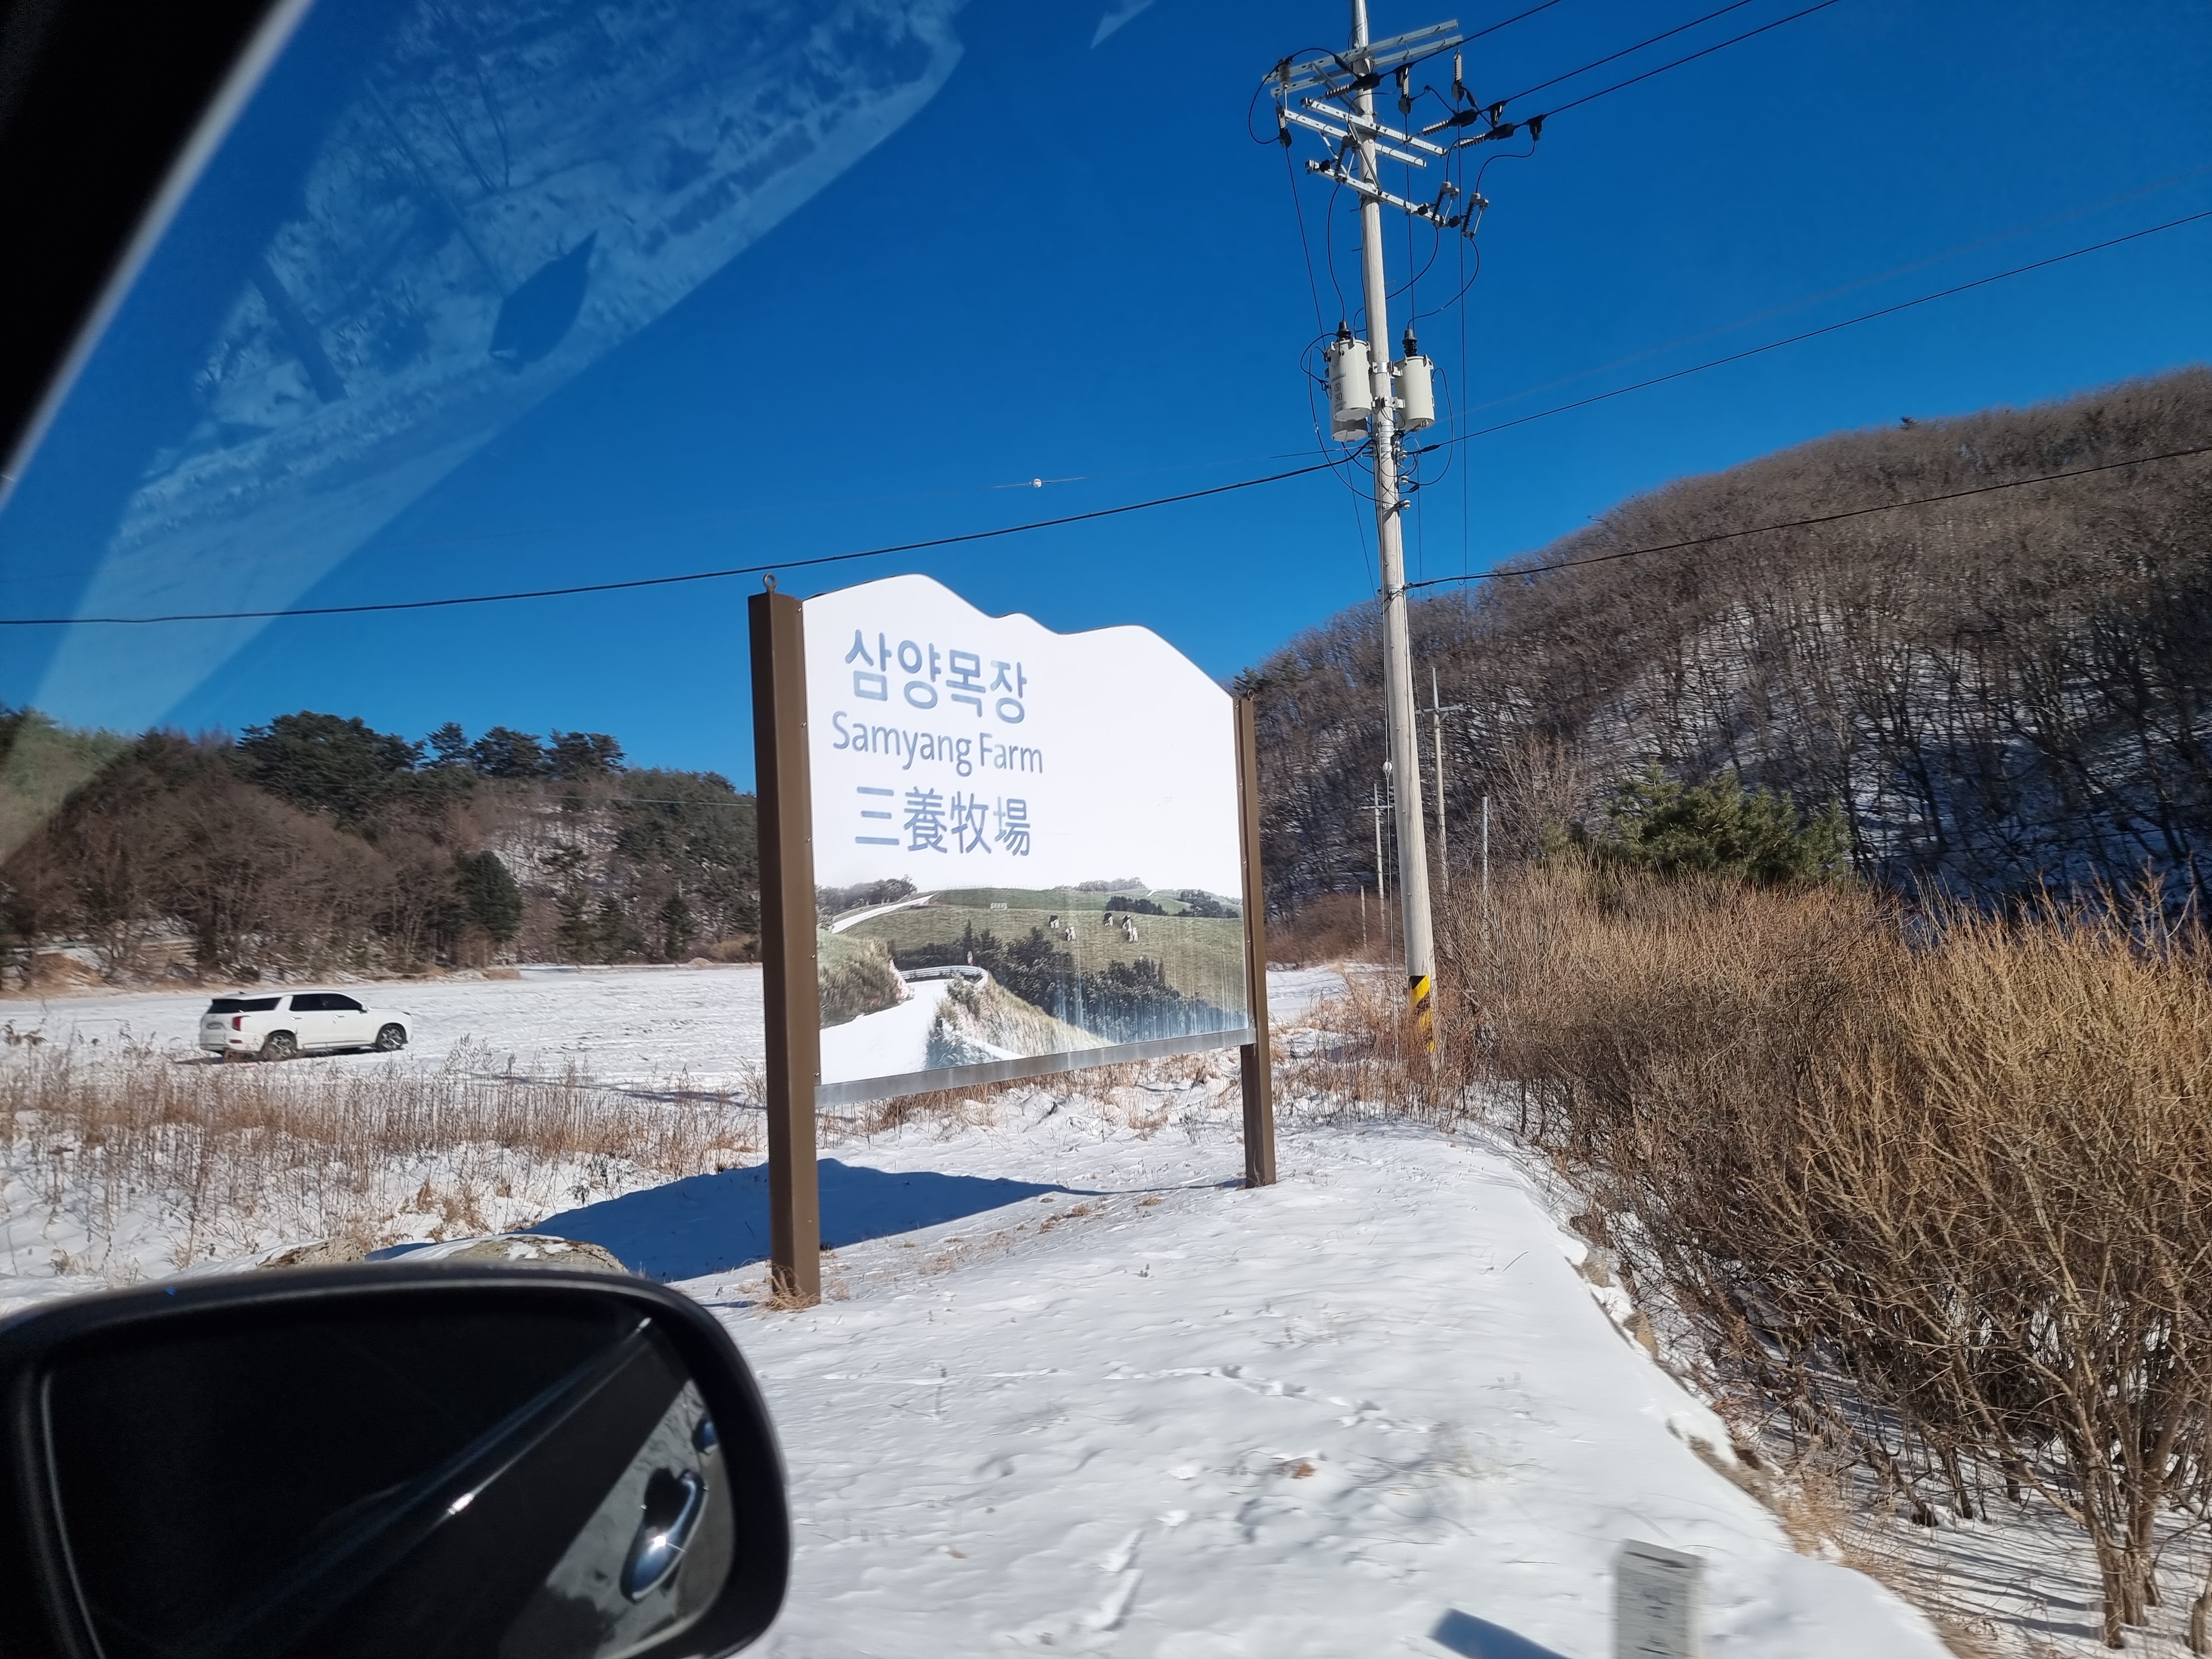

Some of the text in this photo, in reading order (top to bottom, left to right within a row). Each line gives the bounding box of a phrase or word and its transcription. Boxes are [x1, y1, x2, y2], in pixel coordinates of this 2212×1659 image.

[844, 629, 1027, 724] 삼양목장
[832, 711, 1043, 778] Samyang Farm
[855, 786, 1031, 857] 三養牧場
